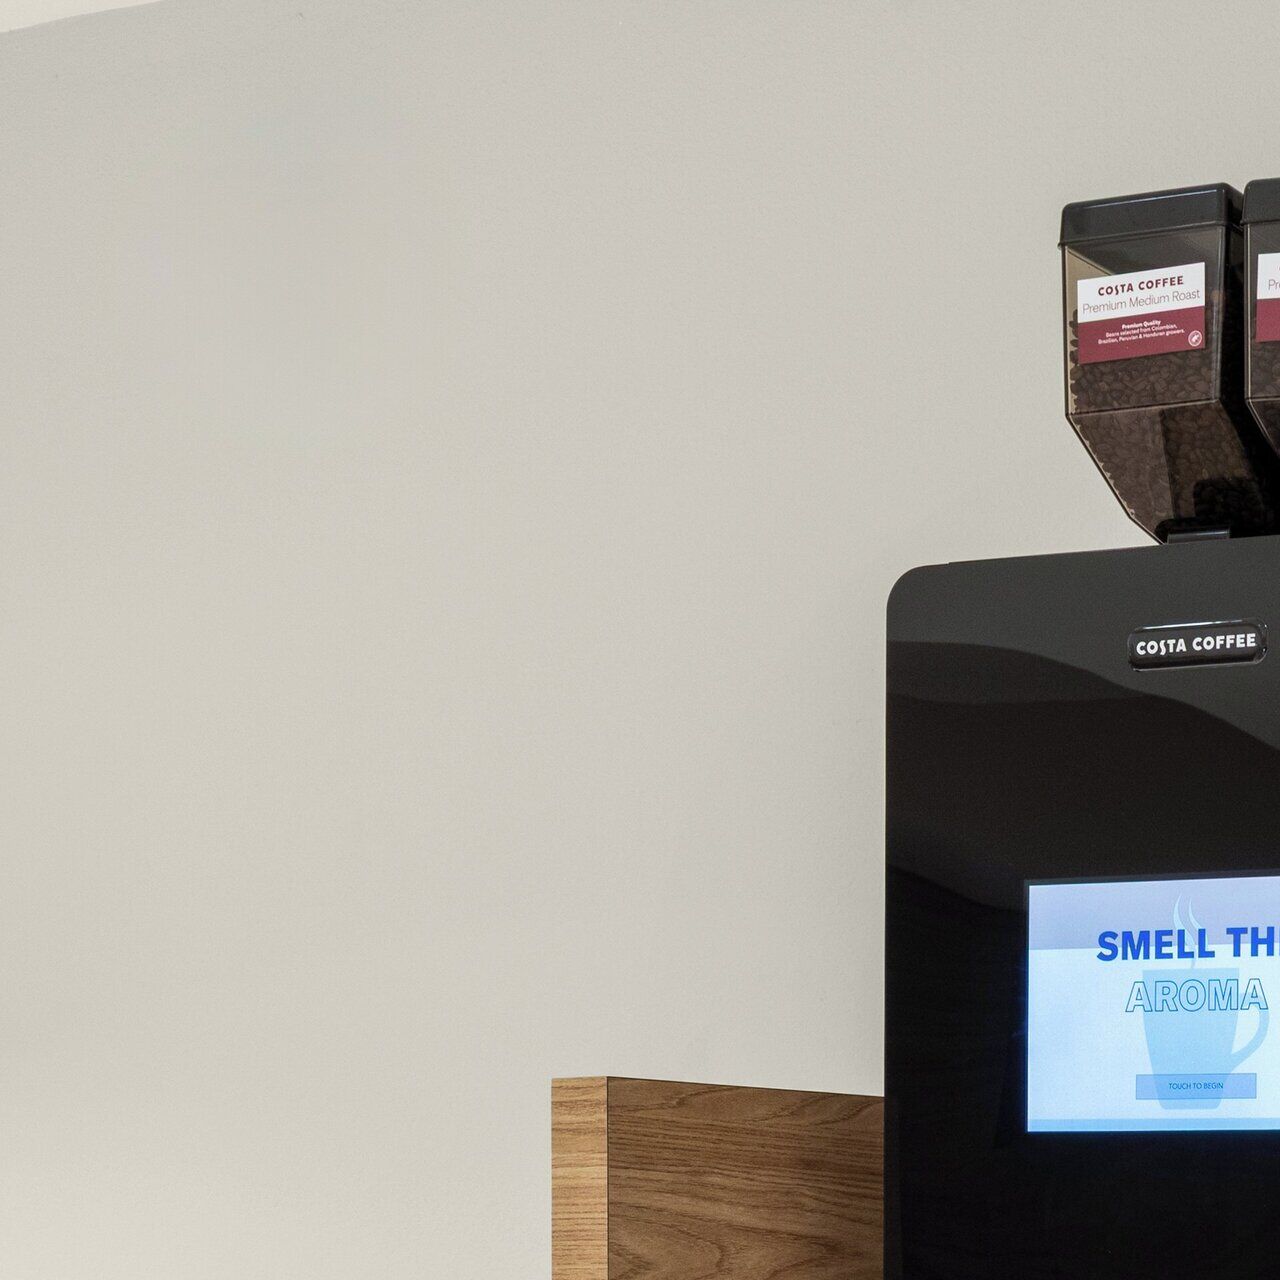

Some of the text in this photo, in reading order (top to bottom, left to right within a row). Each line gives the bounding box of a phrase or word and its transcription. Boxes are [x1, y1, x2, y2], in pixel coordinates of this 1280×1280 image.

[1098, 276, 1184, 296] COSTA COFFEE
[1082, 289, 1200, 314] Premium Medium Roast
[1136, 633, 1257, 656] COSTA COFFEE
[1096, 928, 1216, 962] SMELL
[1125, 978, 1269, 1013] AROMA
[1169, 1082, 1224, 1090] TOUCH TO BEGIN
